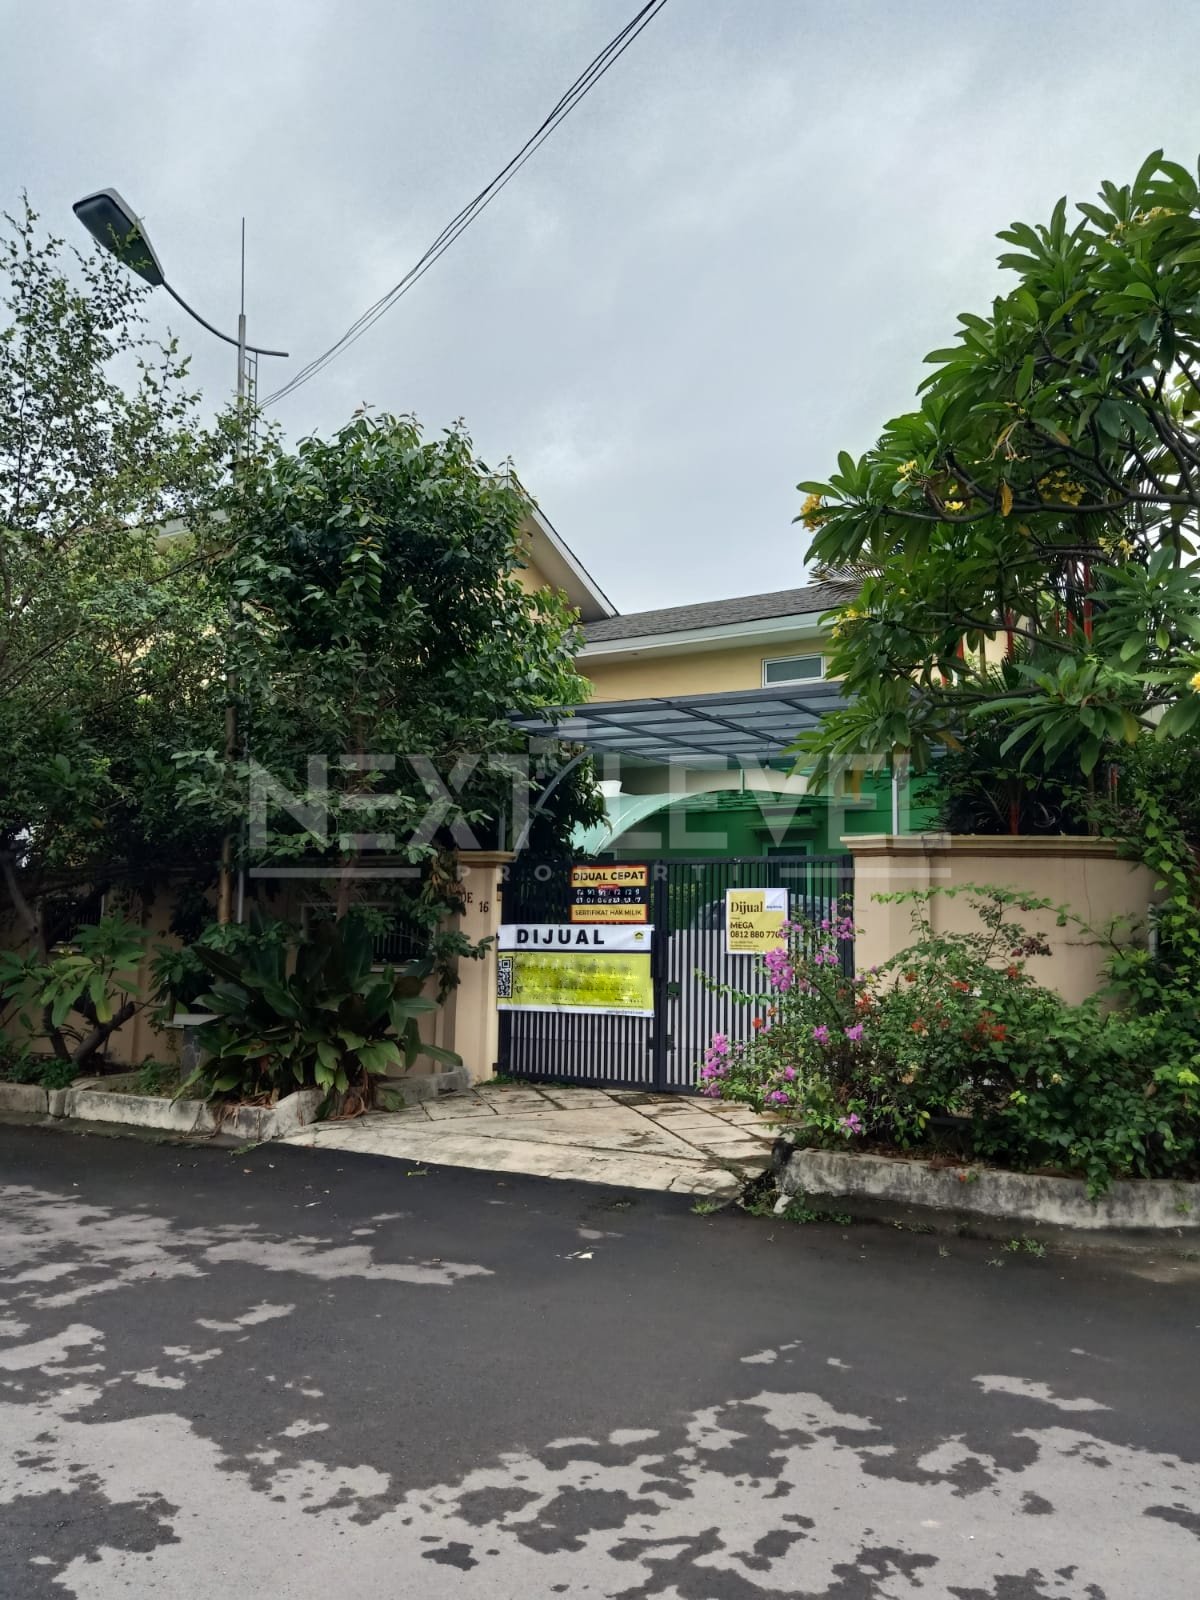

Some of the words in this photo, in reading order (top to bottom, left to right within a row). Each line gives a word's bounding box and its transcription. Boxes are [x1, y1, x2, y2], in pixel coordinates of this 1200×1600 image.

[573, 872, 608, 881] DIJUAL
[610, 871, 645, 881] CEPAT
[479, 900, 489, 913] 16
[730, 901, 763, 915] Dijual
[730, 921, 754, 929] MEGA
[516, 928, 605, 945] DIJUAL
